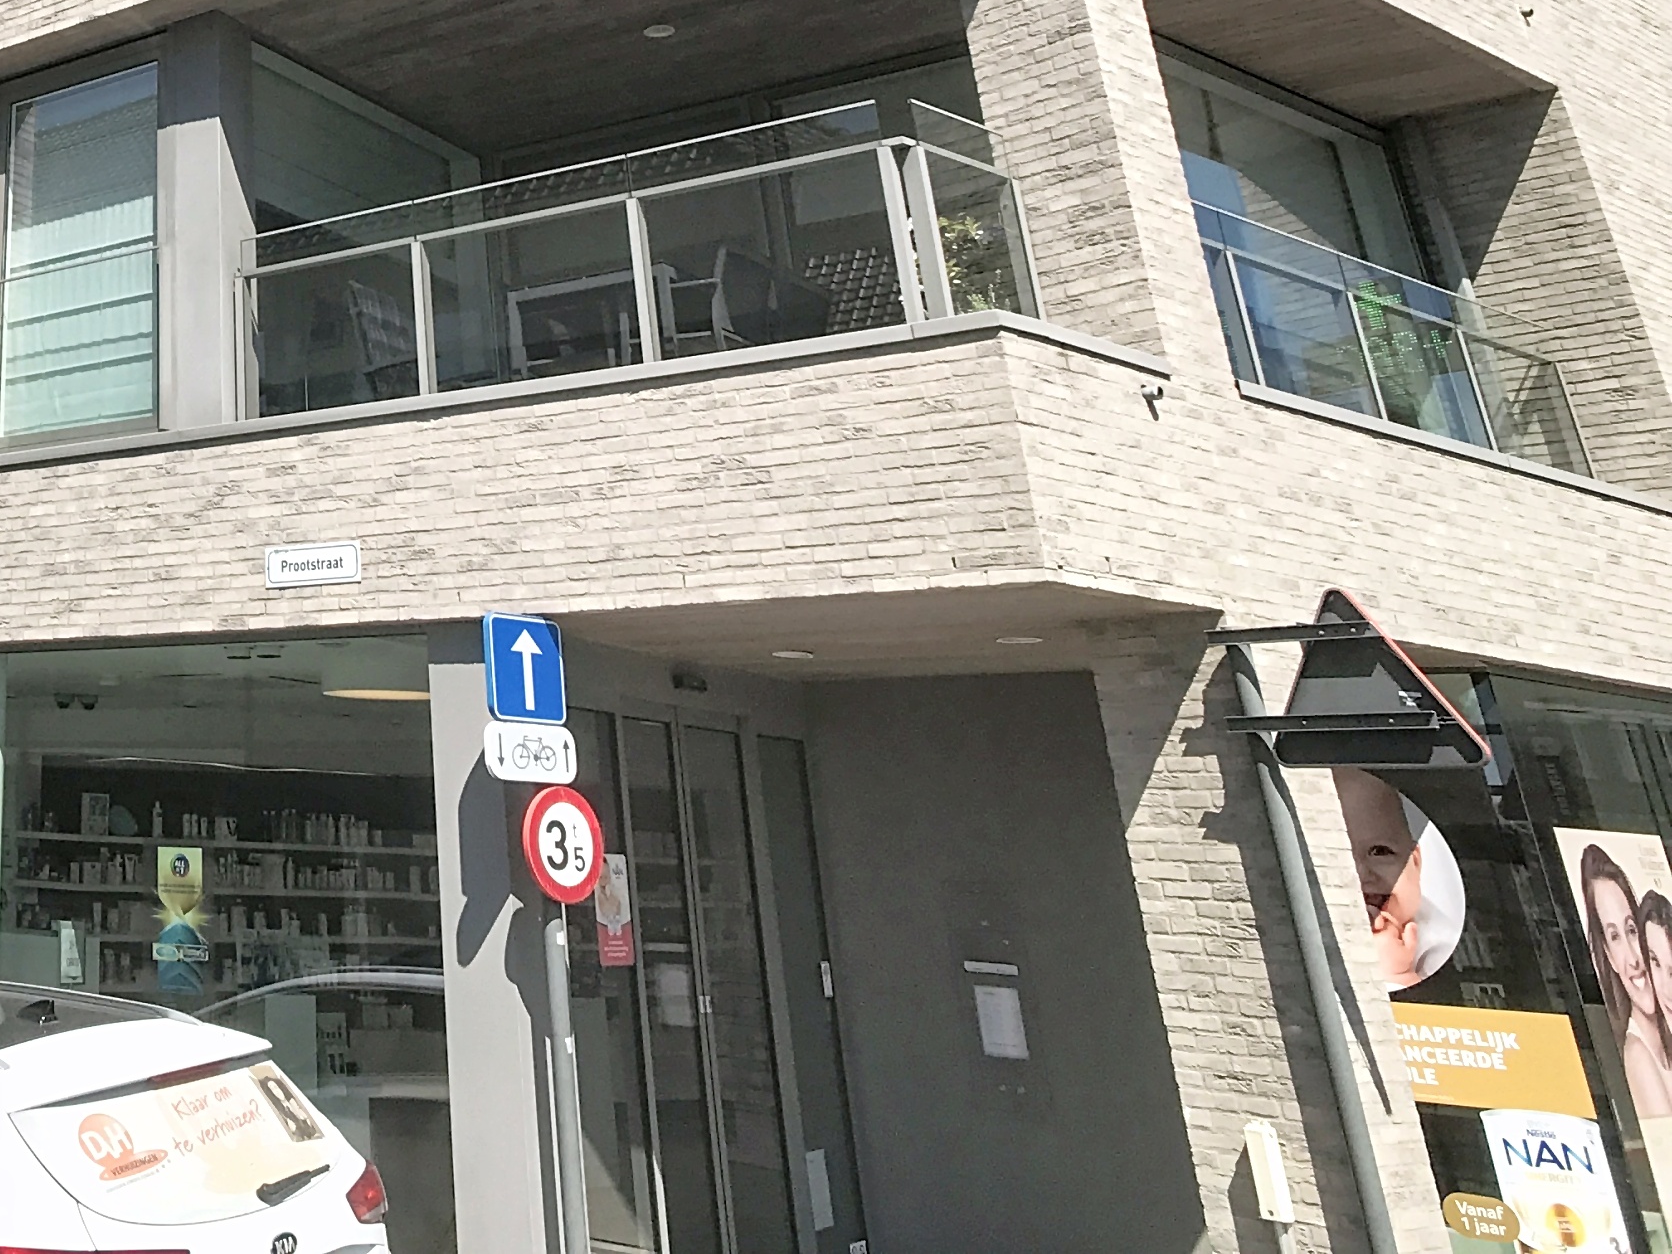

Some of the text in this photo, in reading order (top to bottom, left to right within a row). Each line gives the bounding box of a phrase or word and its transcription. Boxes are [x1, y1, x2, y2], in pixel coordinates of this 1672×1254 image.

[281, 556, 344, 573] Prootstraat
[214, 1086, 233, 1102] om
[172, 1098, 267, 1157] te verhuizen?
[1502, 1137, 1595, 1174] NAN
[1454, 1199, 1504, 1221] Vanaf
[1460, 1216, 1507, 1236] 1 jaar
[274, 1235, 295, 1254] KIA
